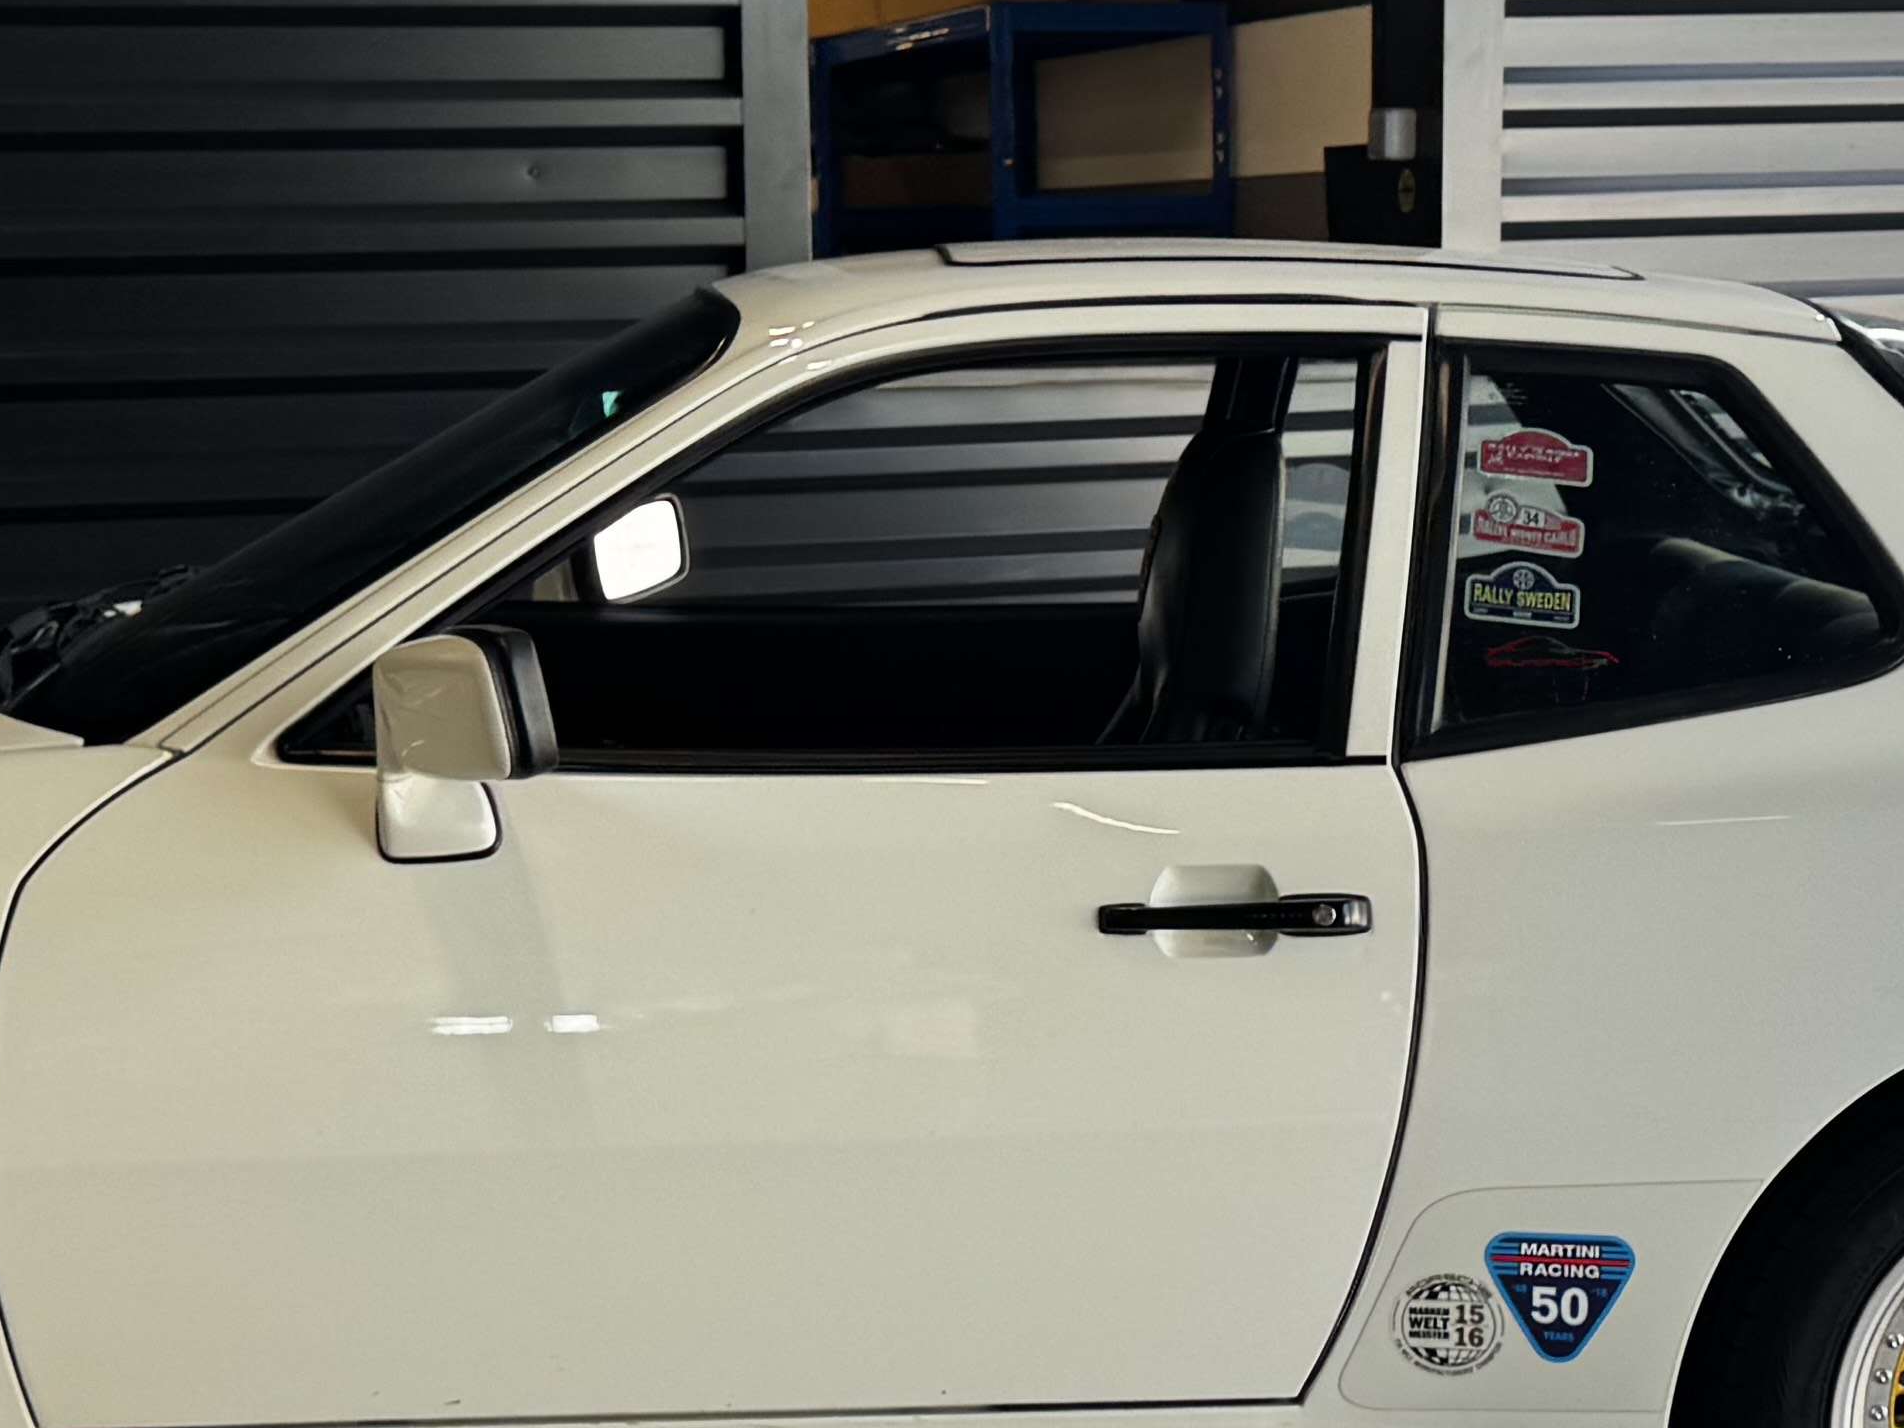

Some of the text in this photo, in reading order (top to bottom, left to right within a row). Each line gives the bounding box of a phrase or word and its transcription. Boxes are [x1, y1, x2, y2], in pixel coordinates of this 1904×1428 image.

[1473, 582, 1572, 612] RALLY SWEDEN
[1520, 1242, 1600, 1258] MARTINI
[1520, 1263, 1600, 1279] RACING
[1455, 1304, 1484, 1325] 15
[1531, 1285, 1589, 1327] 50
[1409, 1317, 1450, 1330] WELT
[1455, 1327, 1484, 1347] 16
[1543, 1331, 1575, 1342] YEARS
